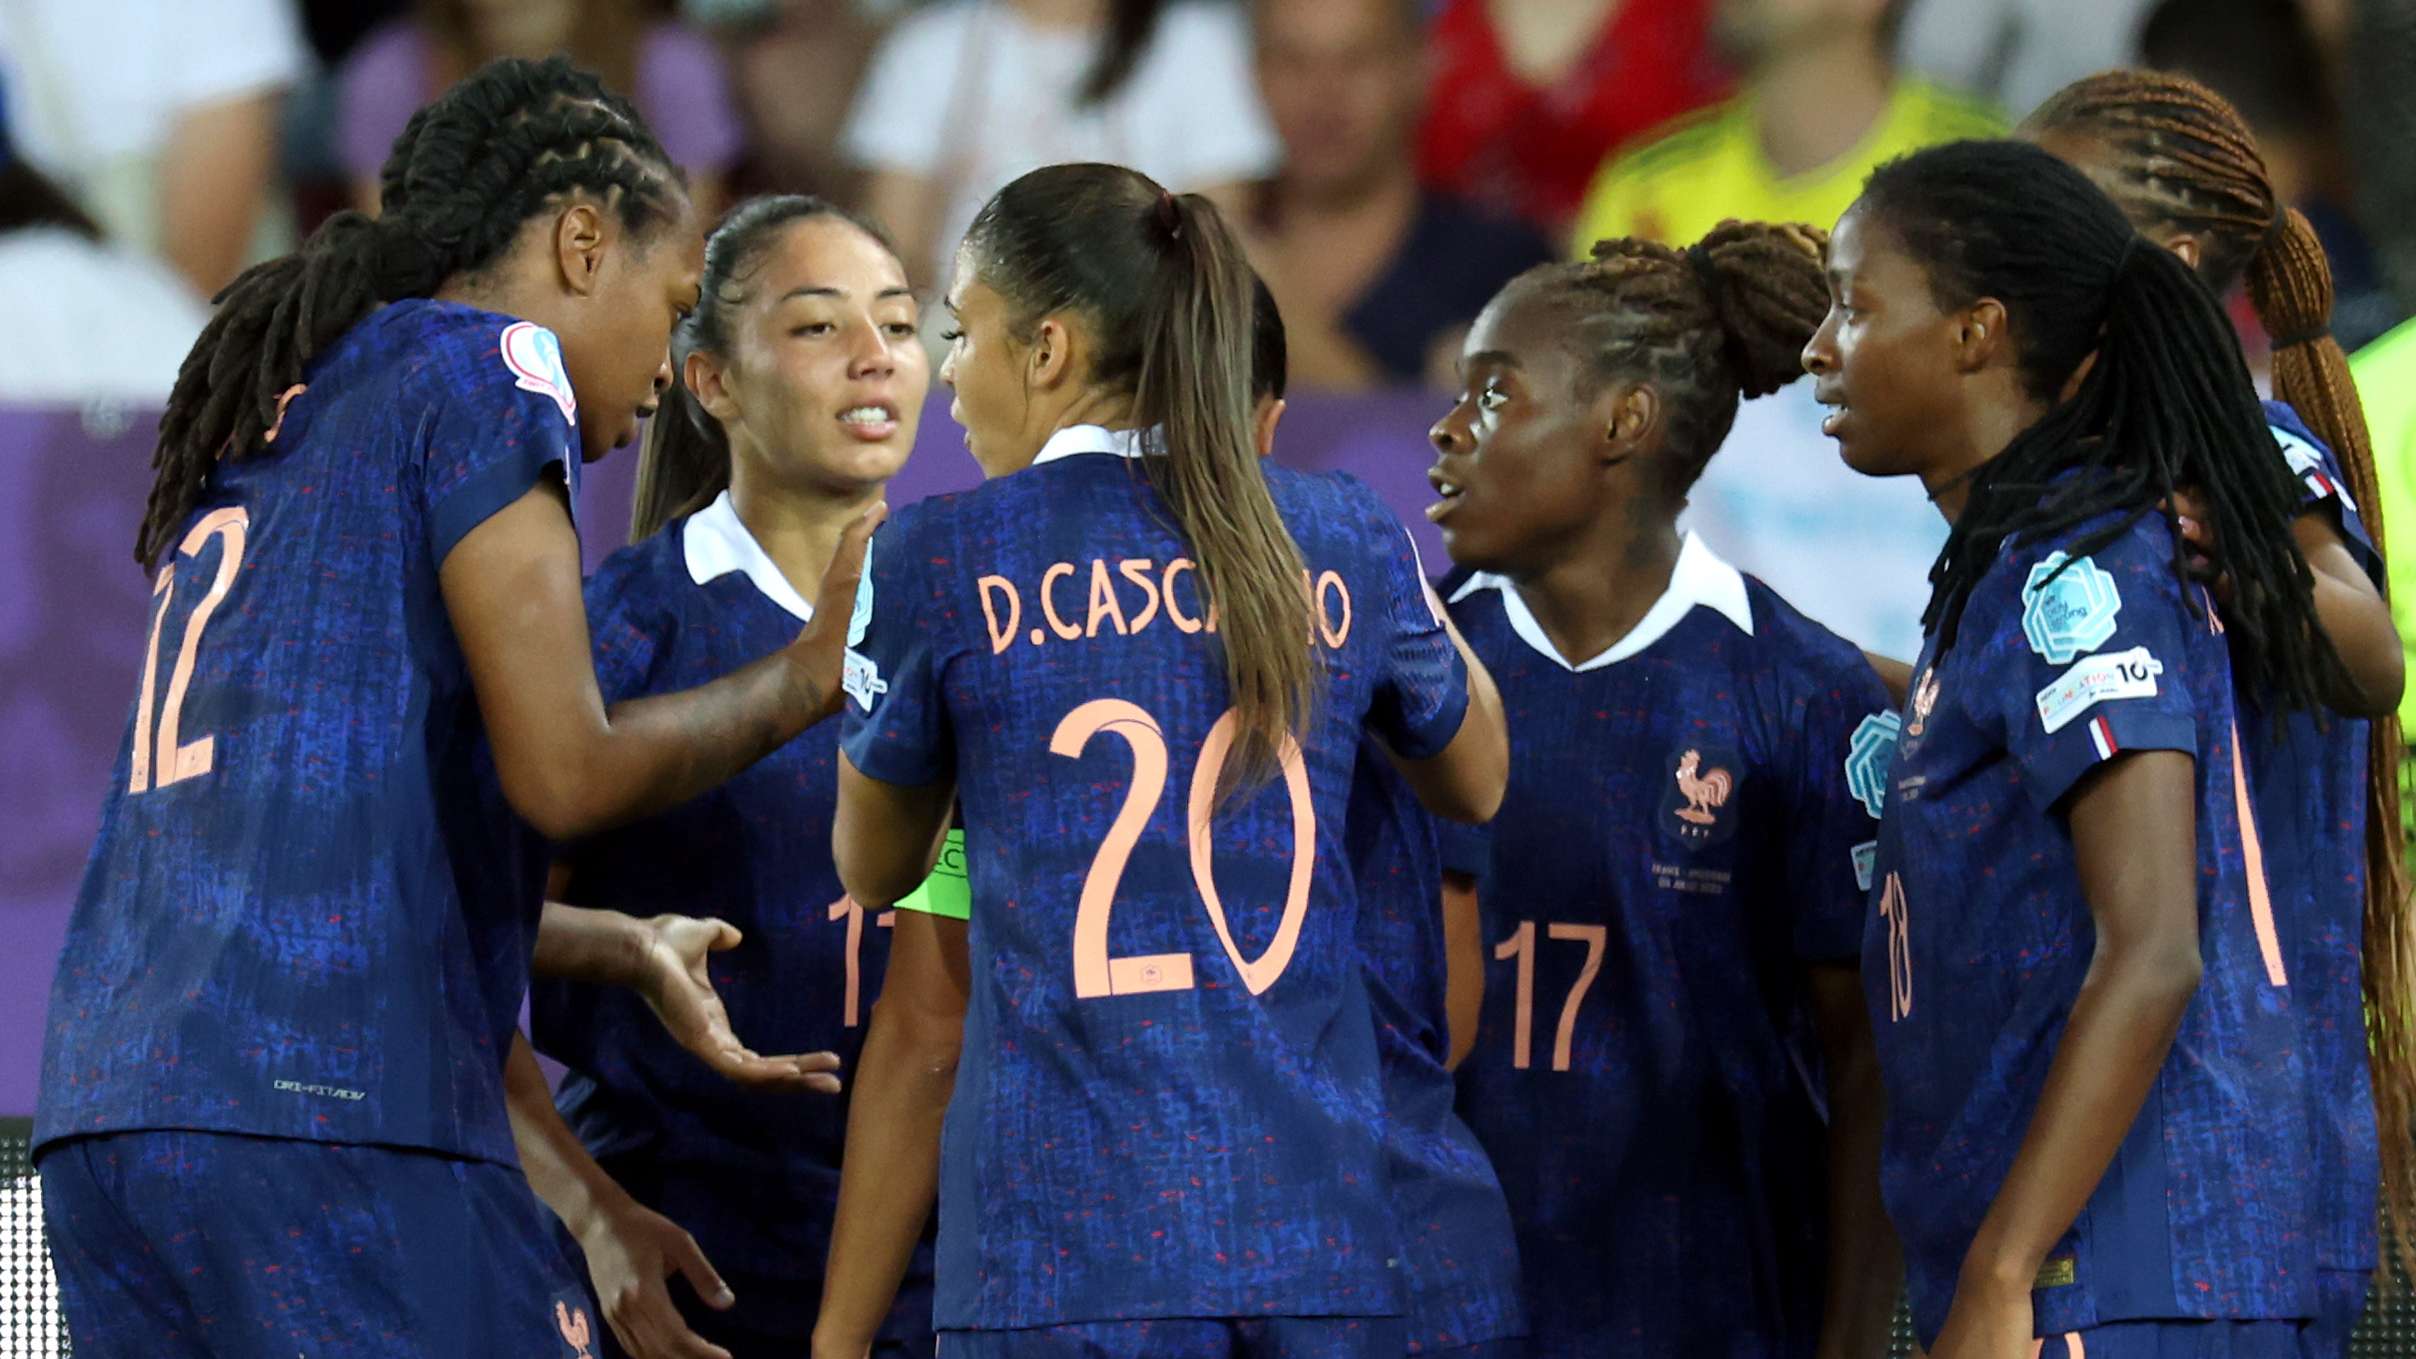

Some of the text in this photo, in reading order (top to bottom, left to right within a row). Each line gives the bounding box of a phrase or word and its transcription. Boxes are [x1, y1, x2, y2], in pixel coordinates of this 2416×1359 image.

[128, 506, 249, 795] 12
[977, 558, 1352, 655] D.CASCO
[1048, 698, 1317, 1000] 20
[828, 893, 896, 1027] 1
[1494, 919, 1607, 1072] 17
[1880, 869, 1913, 1023] 18
